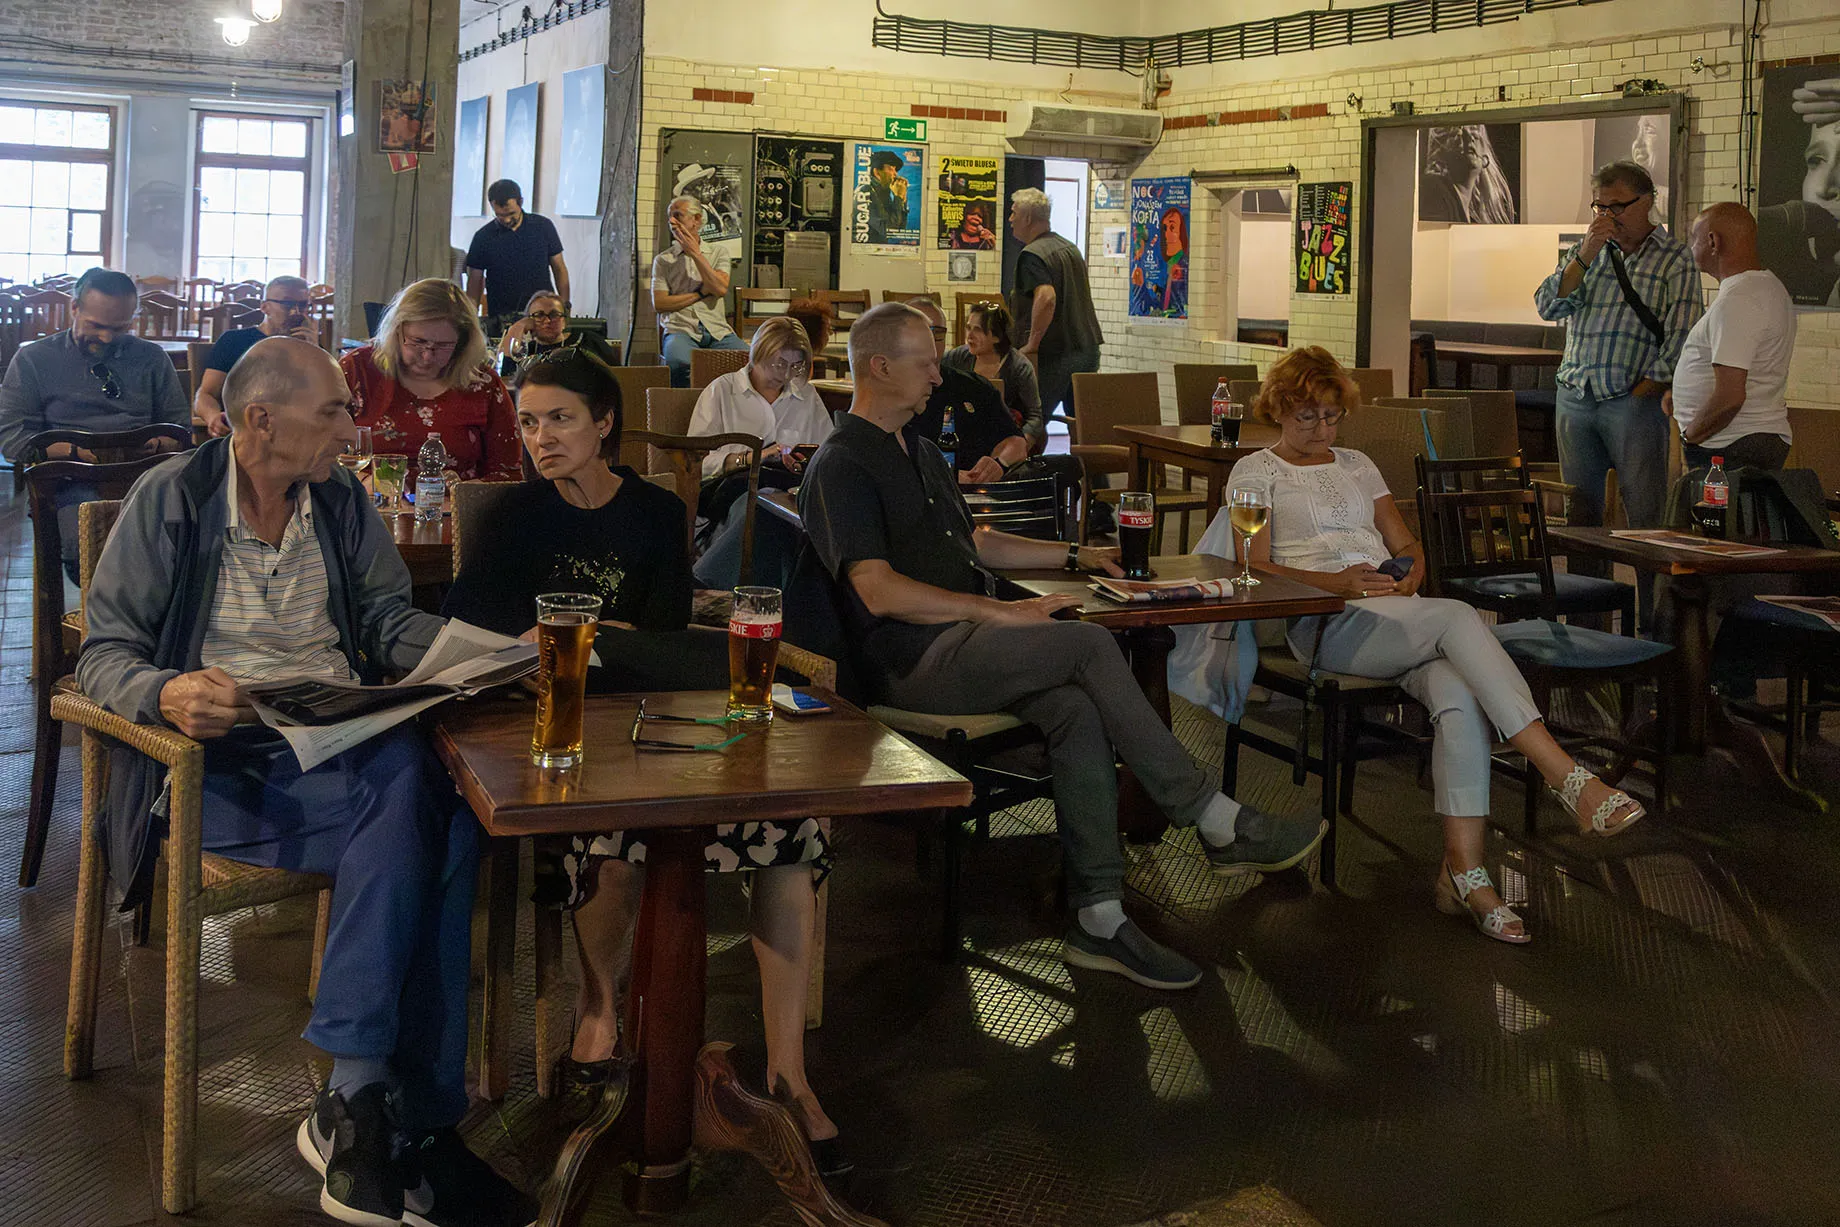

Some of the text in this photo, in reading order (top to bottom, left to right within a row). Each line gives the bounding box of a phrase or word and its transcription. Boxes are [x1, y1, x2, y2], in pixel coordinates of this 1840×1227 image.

[942, 158, 951, 173] 2
[974, 159, 997, 168] BLUESA
[856, 146, 873, 243] SUGAR BLUE
[1132, 186, 1154, 198] NOC
[942, 211, 964, 220] DAVIS
[1300, 220, 1345, 264] JAZZ
[1299, 250, 1344, 294] BLUES
